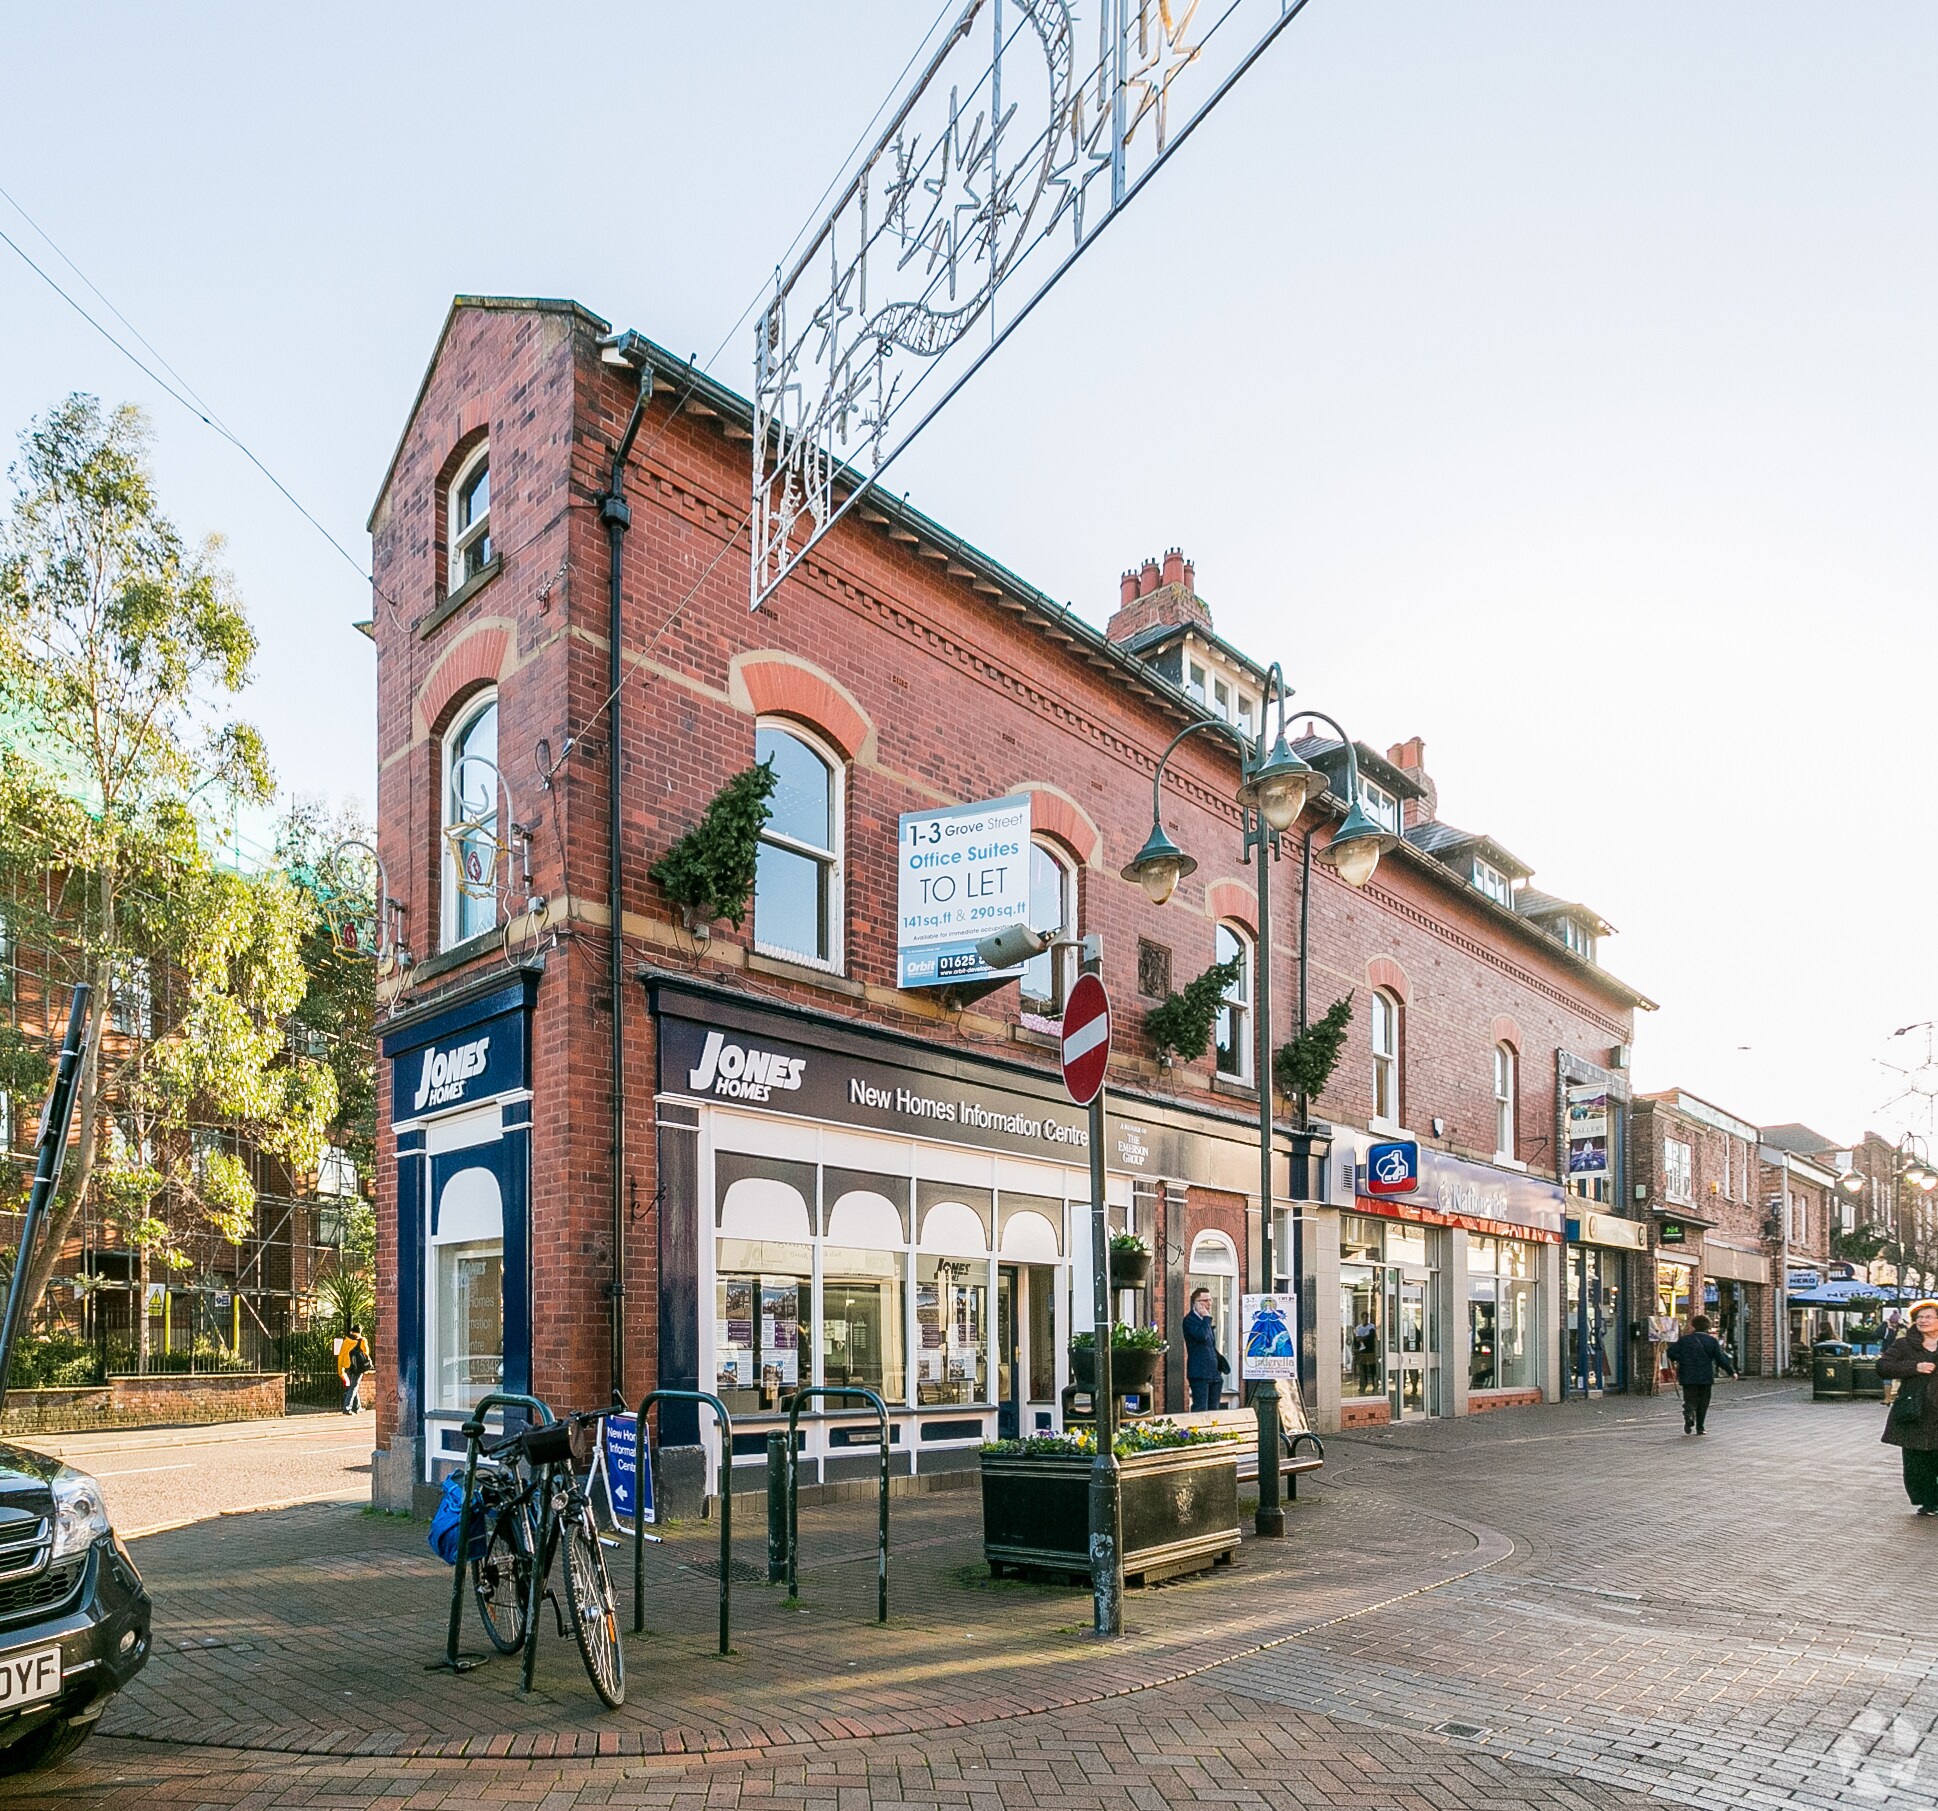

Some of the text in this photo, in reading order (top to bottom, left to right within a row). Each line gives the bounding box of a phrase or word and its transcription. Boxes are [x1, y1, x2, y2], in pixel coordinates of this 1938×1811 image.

[910, 813, 1023, 846] 1-3 Grove Street
[909, 842, 1019, 869] Office Suites
[920, 867, 1008, 904] TO LET
[956, 909, 966, 921] &
[913, 932, 939, 941] Available
[948, 928, 979, 937] immediate
[907, 960, 936, 973] Orbit
[940, 956, 976, 969] 01625
[690, 1031, 807, 1091] JONES
[414, 1036, 490, 1110] JONES
[428, 1080, 466, 1107] HOMES
[715, 1076, 772, 1102] HOMES
[850, 1078, 1089, 1147] New Homes Information Centre
[1571, 1125, 1604, 1134] GALLERY
[1126, 1133, 1141, 1145] THE
[1117, 1140, 1149, 1157] EMERSON
[1122, 1152, 1145, 1166] GROUP
[1790, 1277, 1816, 1285] NERO
[469, 1296, 495, 1308] Homes
[607, 1426, 623, 1439] New
